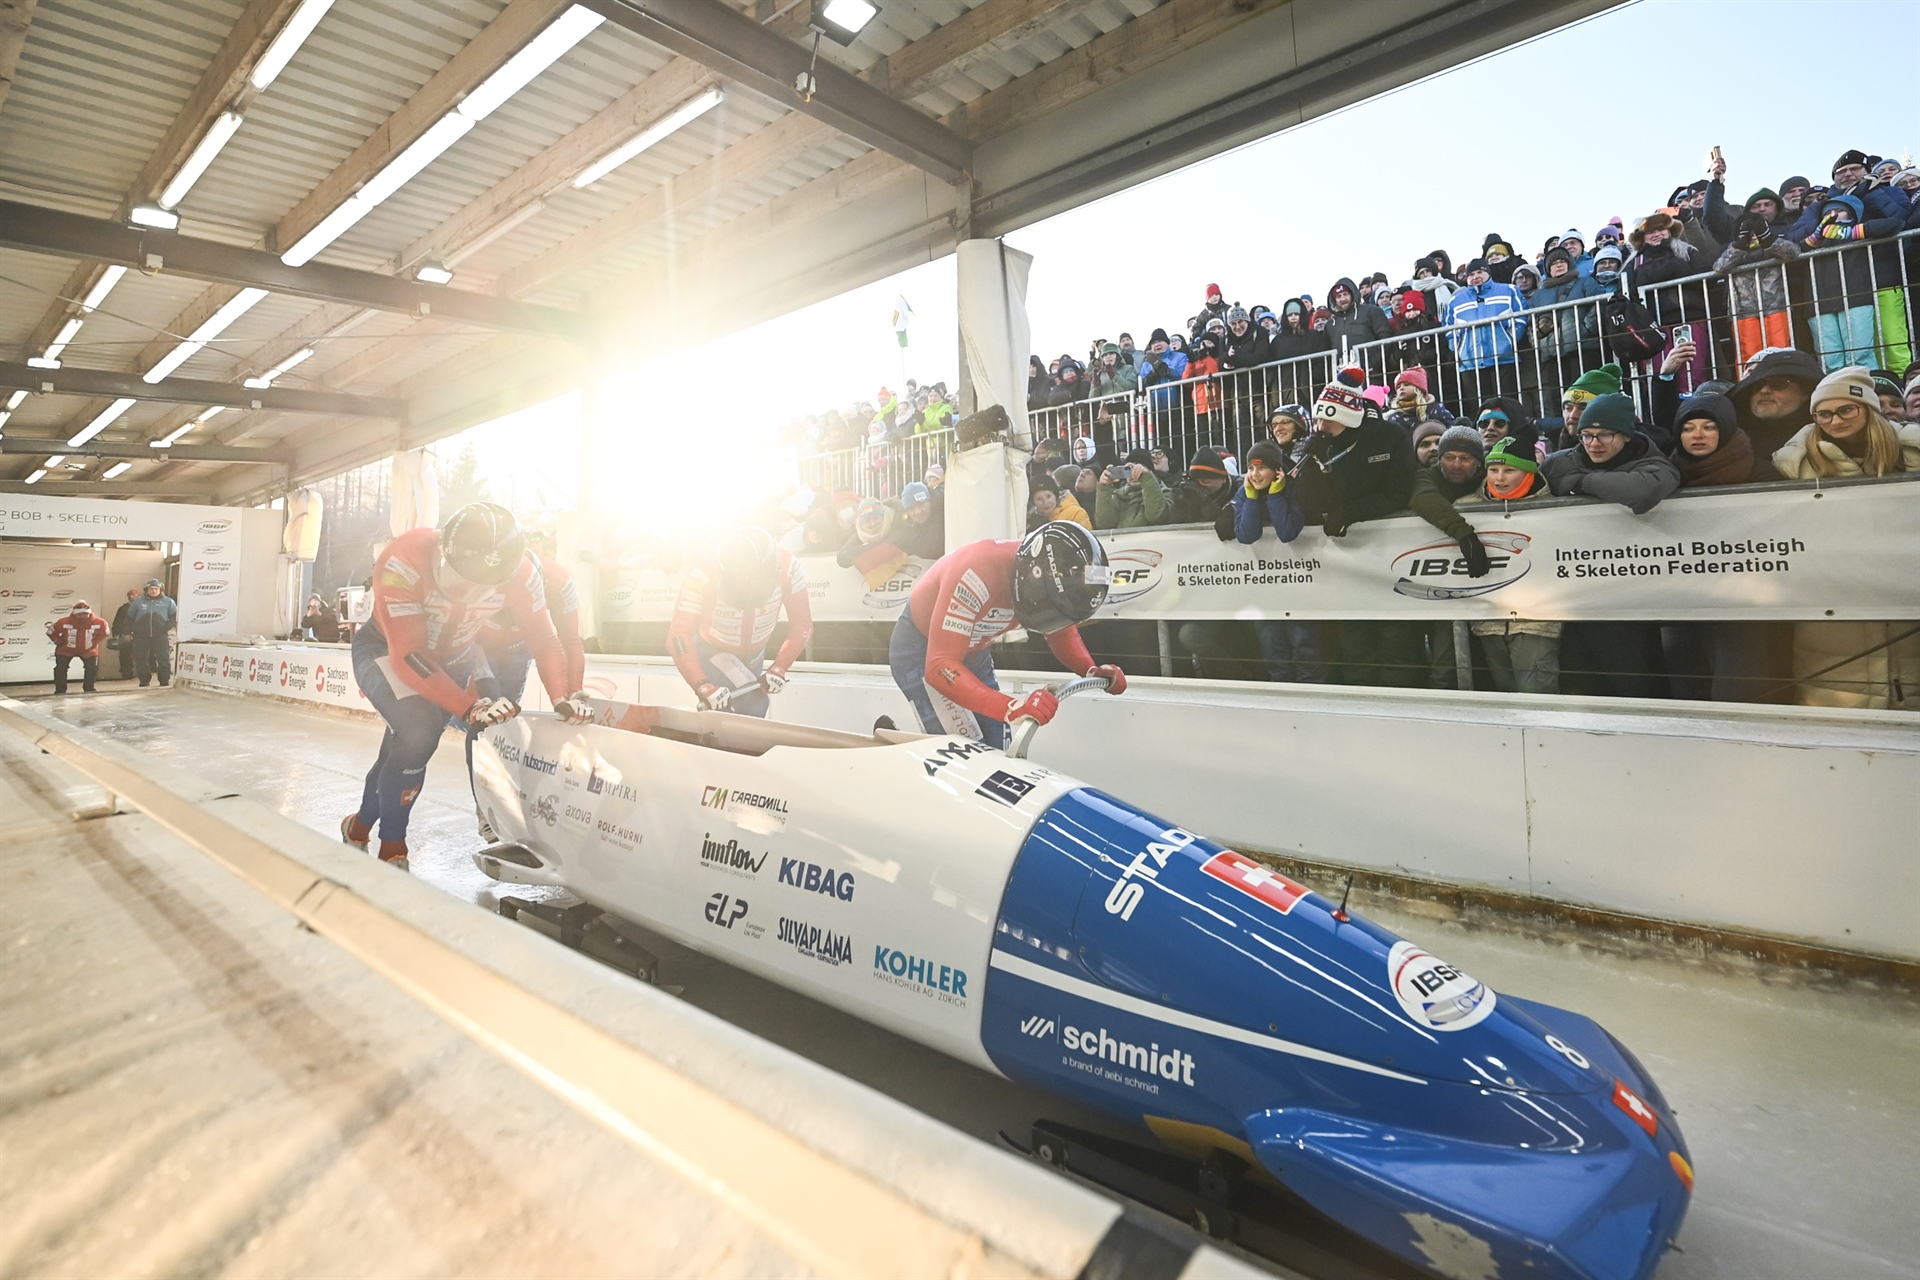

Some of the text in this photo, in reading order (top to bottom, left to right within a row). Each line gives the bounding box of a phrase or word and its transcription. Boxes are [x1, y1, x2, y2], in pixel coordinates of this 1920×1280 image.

[11, 511, 42, 521] BOB
[58, 513, 128, 525] SKELETON
[1555, 536, 1805, 562] International Bobsleigh
[1045, 543, 1065, 593] STADLER
[1177, 558, 1321, 574] International Bobsleigh
[1556, 557, 1789, 578] & Skeleton Federation
[870, 580, 912, 593] BSF
[1177, 572, 1313, 587] & Skeleton Federation
[256, 672, 272, 684] Energie
[257, 659, 274, 672] Sachsen
[289, 663, 308, 676] Sachsen
[327, 667, 349, 681] Sachsen
[288, 676, 306, 690] Energie
[326, 682, 347, 697] Energie
[522, 751, 559, 776] hubschmid
[923, 741, 995, 777] AMME
[593, 775, 637, 802] EMPIRA
[565, 804, 592, 824] axova
[730, 790, 789, 813] CARBOMILL
[701, 832, 768, 874] innflow
[778, 856, 855, 902] KIBAG
[1105, 827, 1200, 922] STAD
[777, 916, 853, 965] SILVAPLANA
[874, 945, 968, 998] KOHLER
[873, 971, 893, 984] HANS
[894, 978, 921, 994] KOHLER
[922, 988, 934, 998] AG
[1063, 1025, 1196, 1087] schmidt
[1544, 1034, 1590, 1069] 8
[1062, 1056, 1160, 1096] a brand of aebi schmidt
